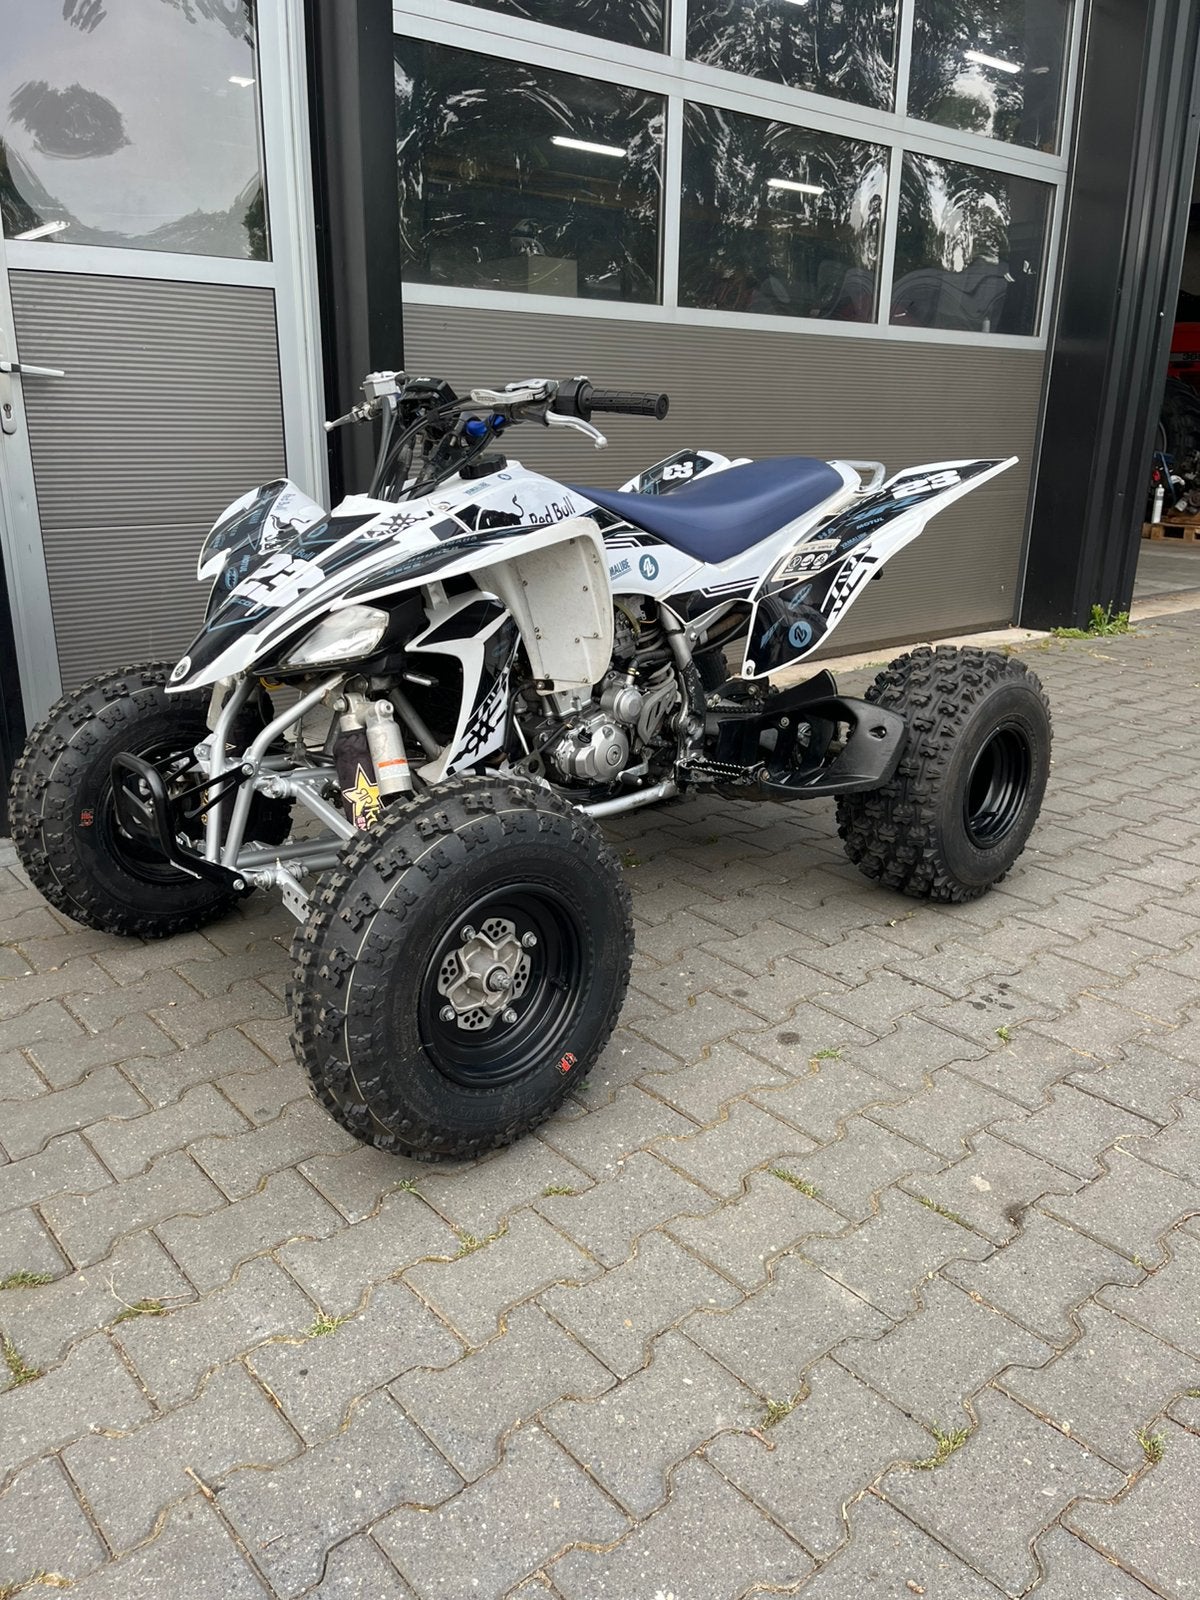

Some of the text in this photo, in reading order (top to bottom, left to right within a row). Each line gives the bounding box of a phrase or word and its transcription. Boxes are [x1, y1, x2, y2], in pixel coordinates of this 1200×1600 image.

[891, 469, 962, 500] 23
[551, 495, 576, 521] Bull
[856, 517, 885, 530] MOTUL
